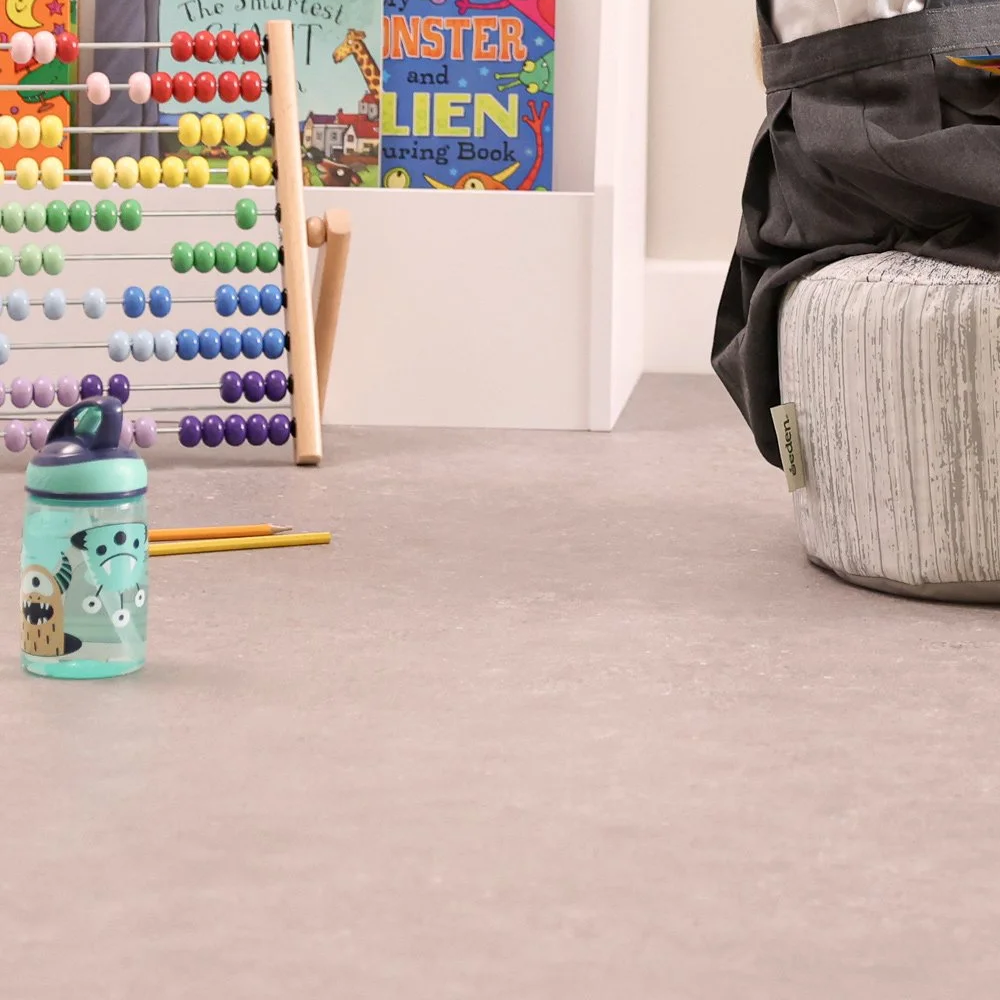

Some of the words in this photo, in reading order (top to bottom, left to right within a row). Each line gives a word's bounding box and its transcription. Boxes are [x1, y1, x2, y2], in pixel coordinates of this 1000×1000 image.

[406, 65, 449, 85] and
[382, 92, 519, 138] LIEN
[457, 141, 518, 162] Book
